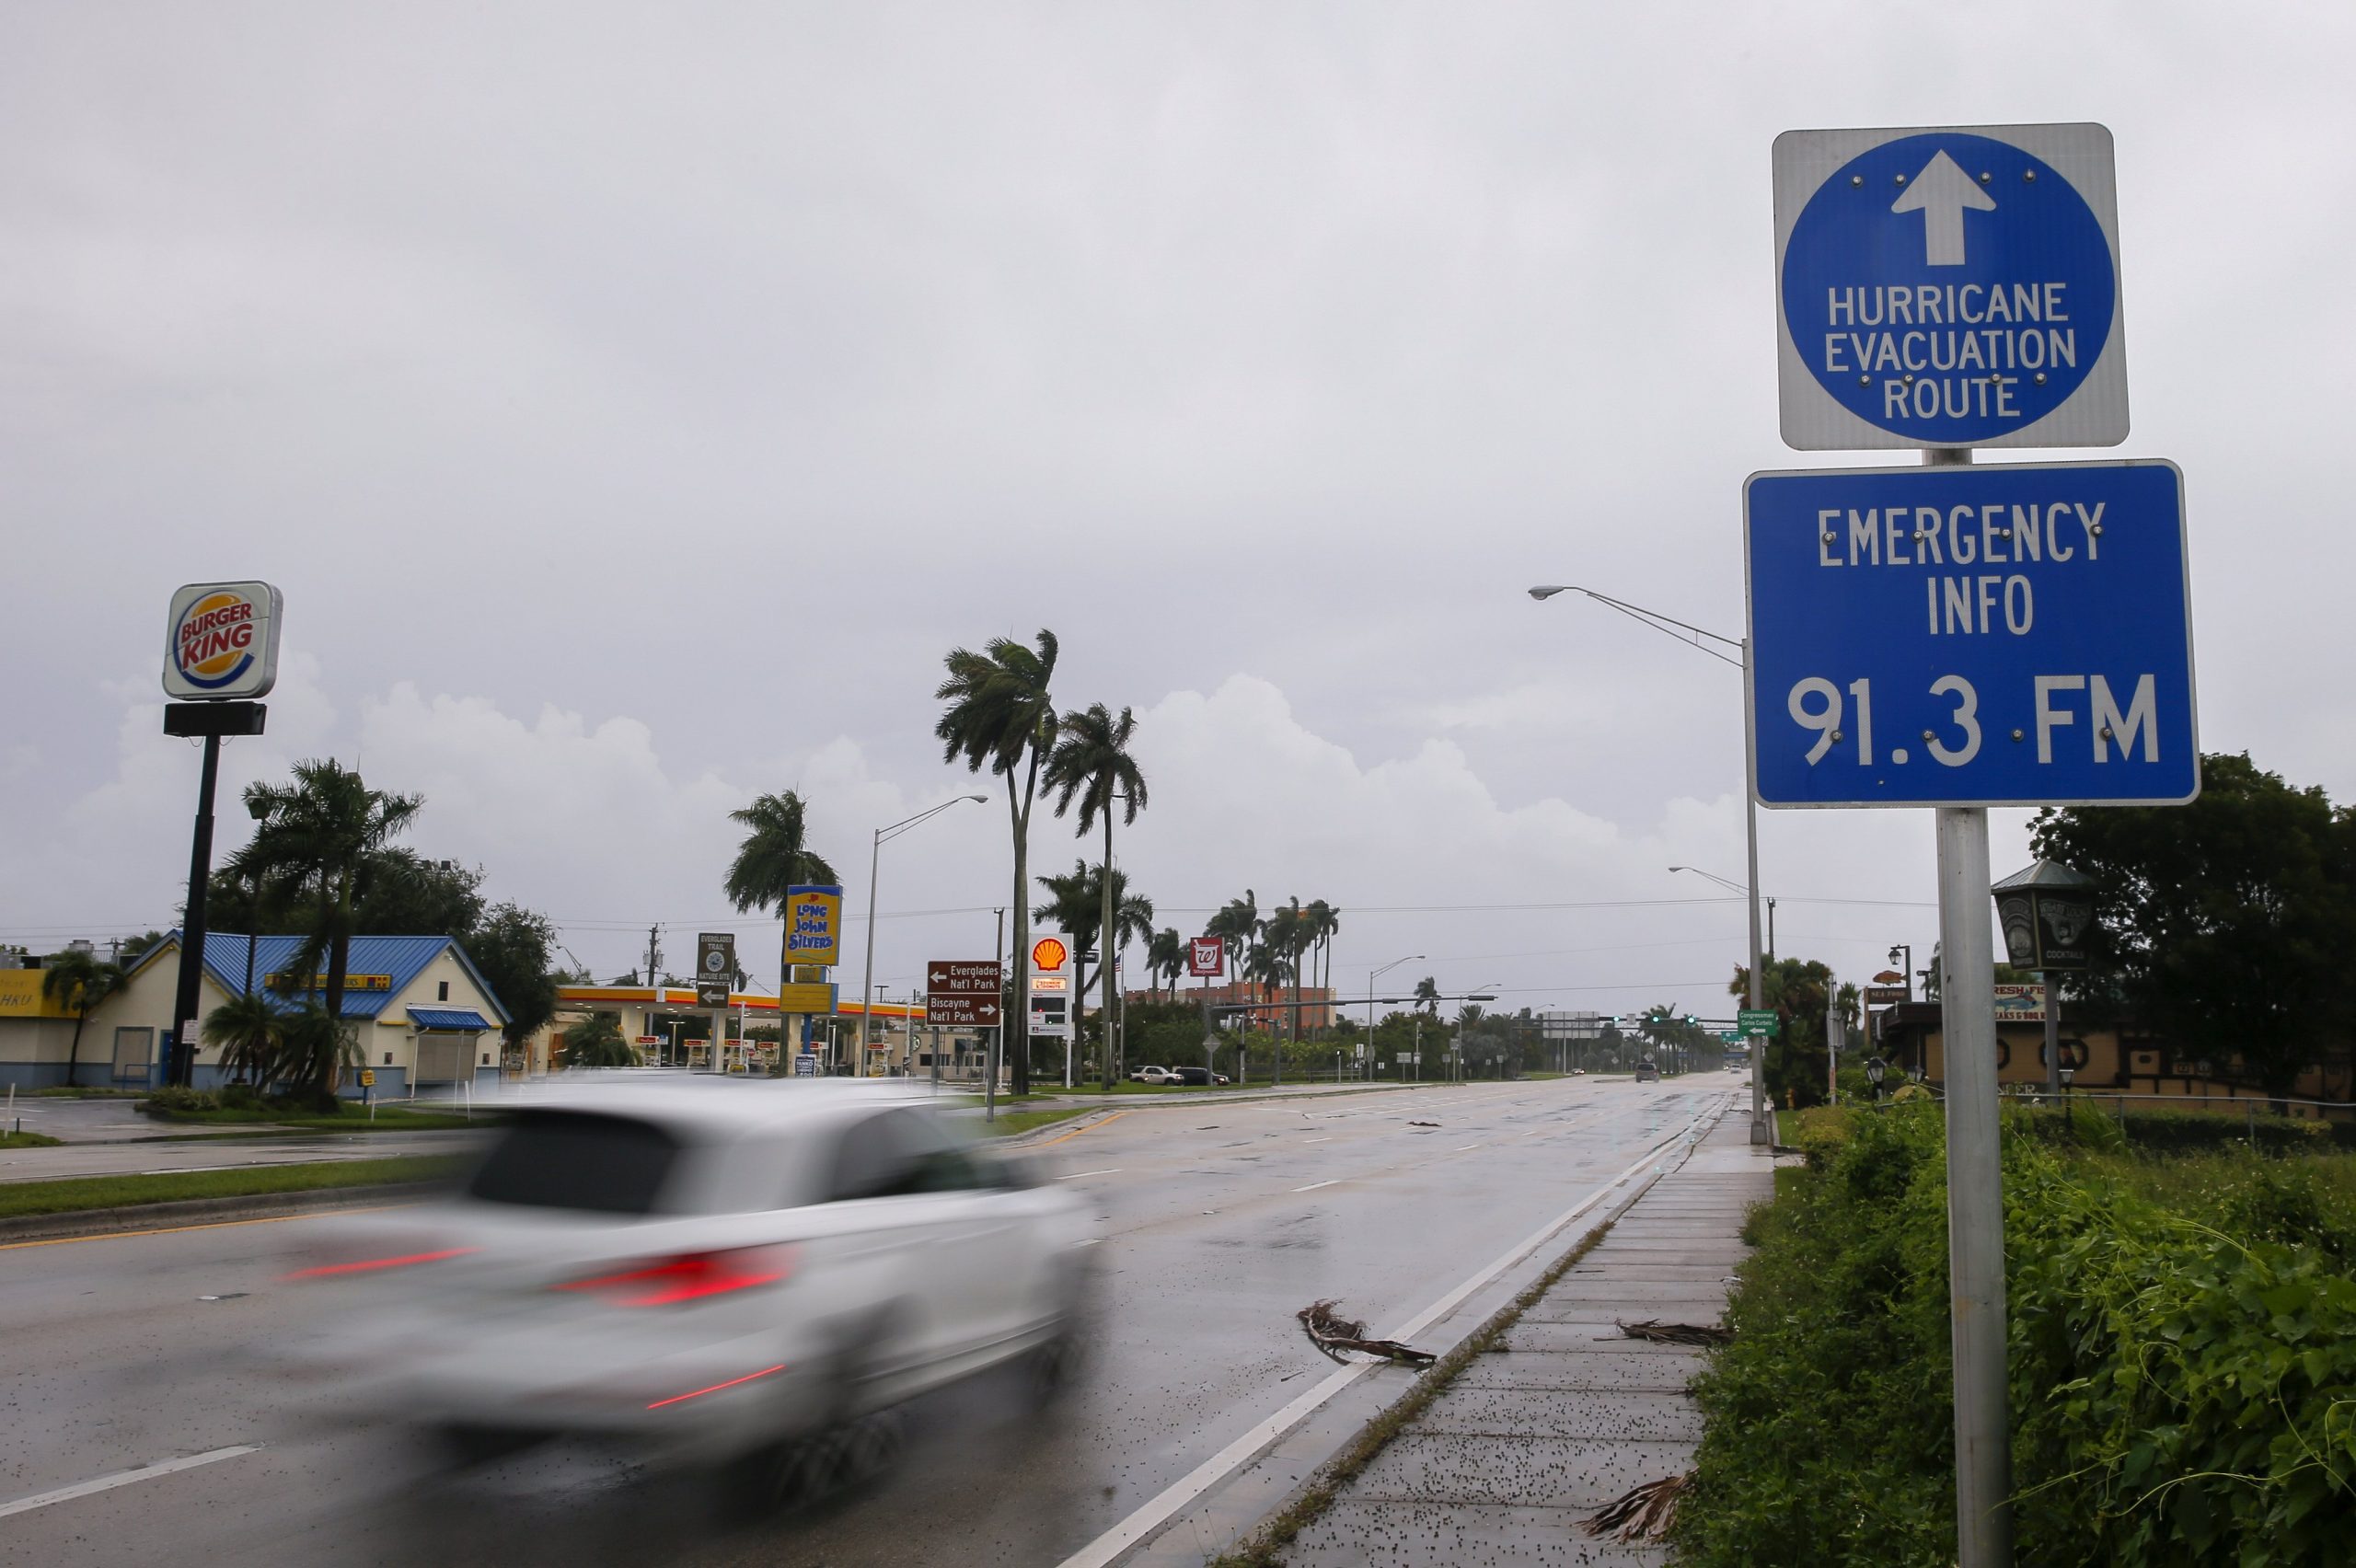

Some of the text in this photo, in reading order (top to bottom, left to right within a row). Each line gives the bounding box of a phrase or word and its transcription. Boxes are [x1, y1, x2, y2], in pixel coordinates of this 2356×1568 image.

[1828, 282, 2070, 326] HURRICANE
[1825, 329, 2076, 373] EVACUATION
[1884, 377, 2021, 419] ROUTE
[1818, 502, 2106, 567] EMERGENCY
[1926, 575, 2033, 636] INFO
[181, 603, 252, 644] BURGER
[182, 623, 253, 670] KING
[1787, 674, 2159, 767] 91.3 FM
[796, 905, 827, 917] LONG
[700, 935, 733, 943] EVERGLADES
[2046, 950, 2085, 959] COCKTAILS
[951, 965, 999, 978] Everglades
[950, 978, 995, 989] Nat'l Park
[1994, 986, 2046, 995] RESH FIS
[0, 994, 33, 1007] HRU
[930, 997, 970, 1009] Biscayne
[930, 1011, 975, 1021] Nat'l Park
